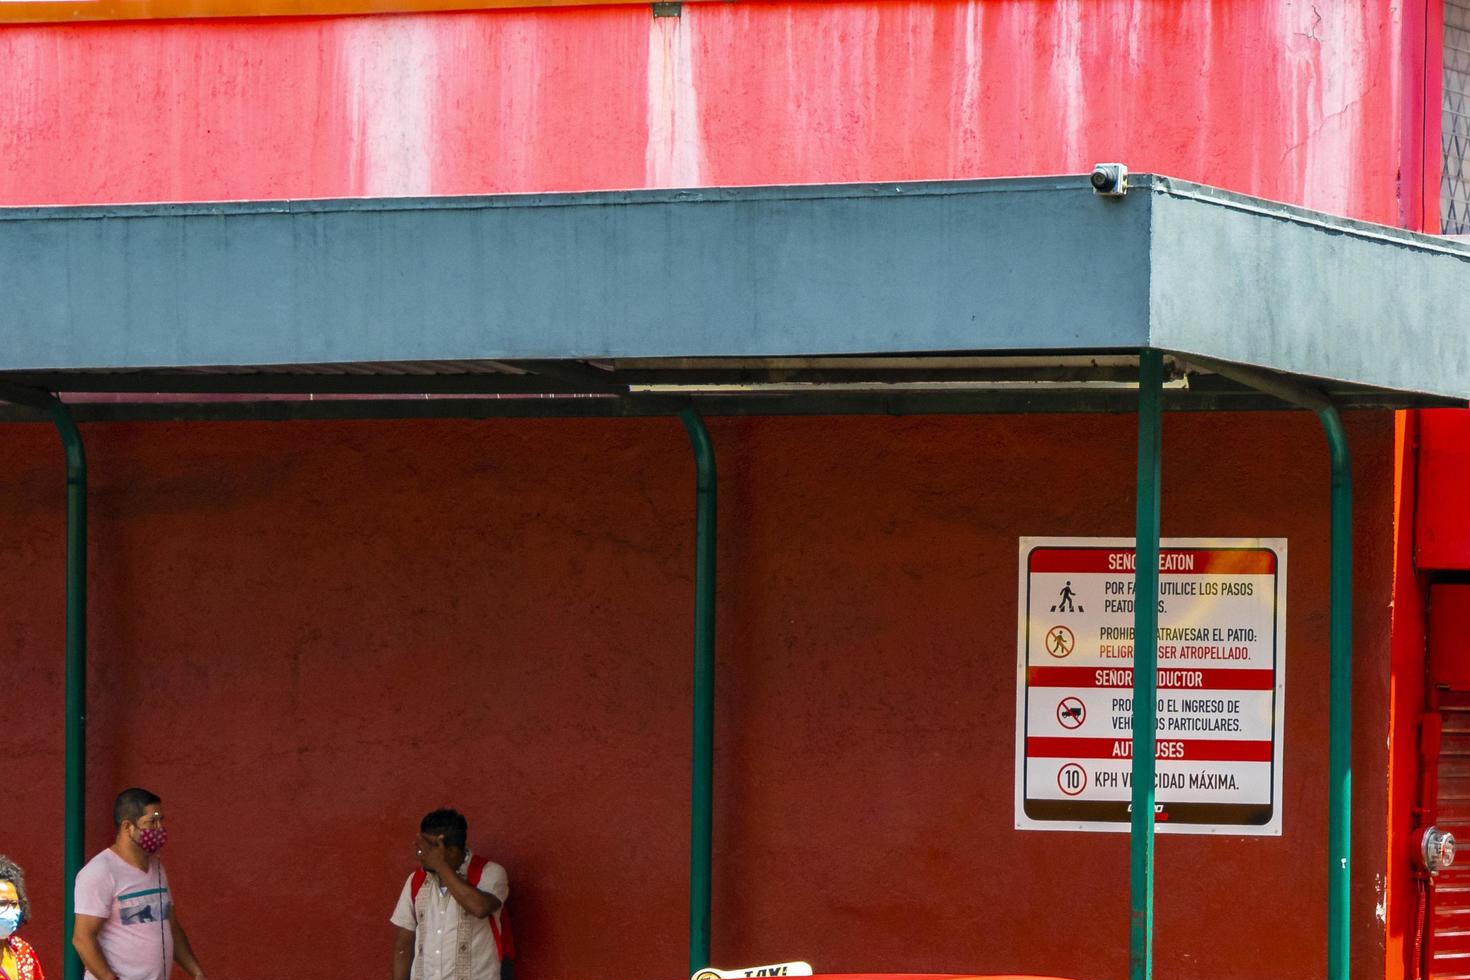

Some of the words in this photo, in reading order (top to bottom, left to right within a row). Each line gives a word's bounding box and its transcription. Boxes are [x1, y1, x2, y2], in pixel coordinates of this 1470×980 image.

[1105, 582, 1124, 595] POR
[1161, 582, 1196, 596] UTILICE
[1199, 582, 1218, 596] LOS
[1221, 582, 1253, 596] PASOS
[1212, 628, 1224, 642] EL
[1227, 629, 1257, 642] PATIO:
[1158, 646, 1176, 659] SER
[1180, 646, 1251, 660] ATROPELLADO.
[1095, 669, 1132, 686] SEÑOR
[1167, 700, 1179, 713] EL
[1182, 700, 1224, 713] INGRESO
[1227, 700, 1240, 713] DE
[1168, 718, 1242, 732] PARTICULARES.
[1065, 770, 1080, 789] 10
[1095, 772, 1117, 788] KPH
[1189, 770, 1239, 790] MÁXIMA.
